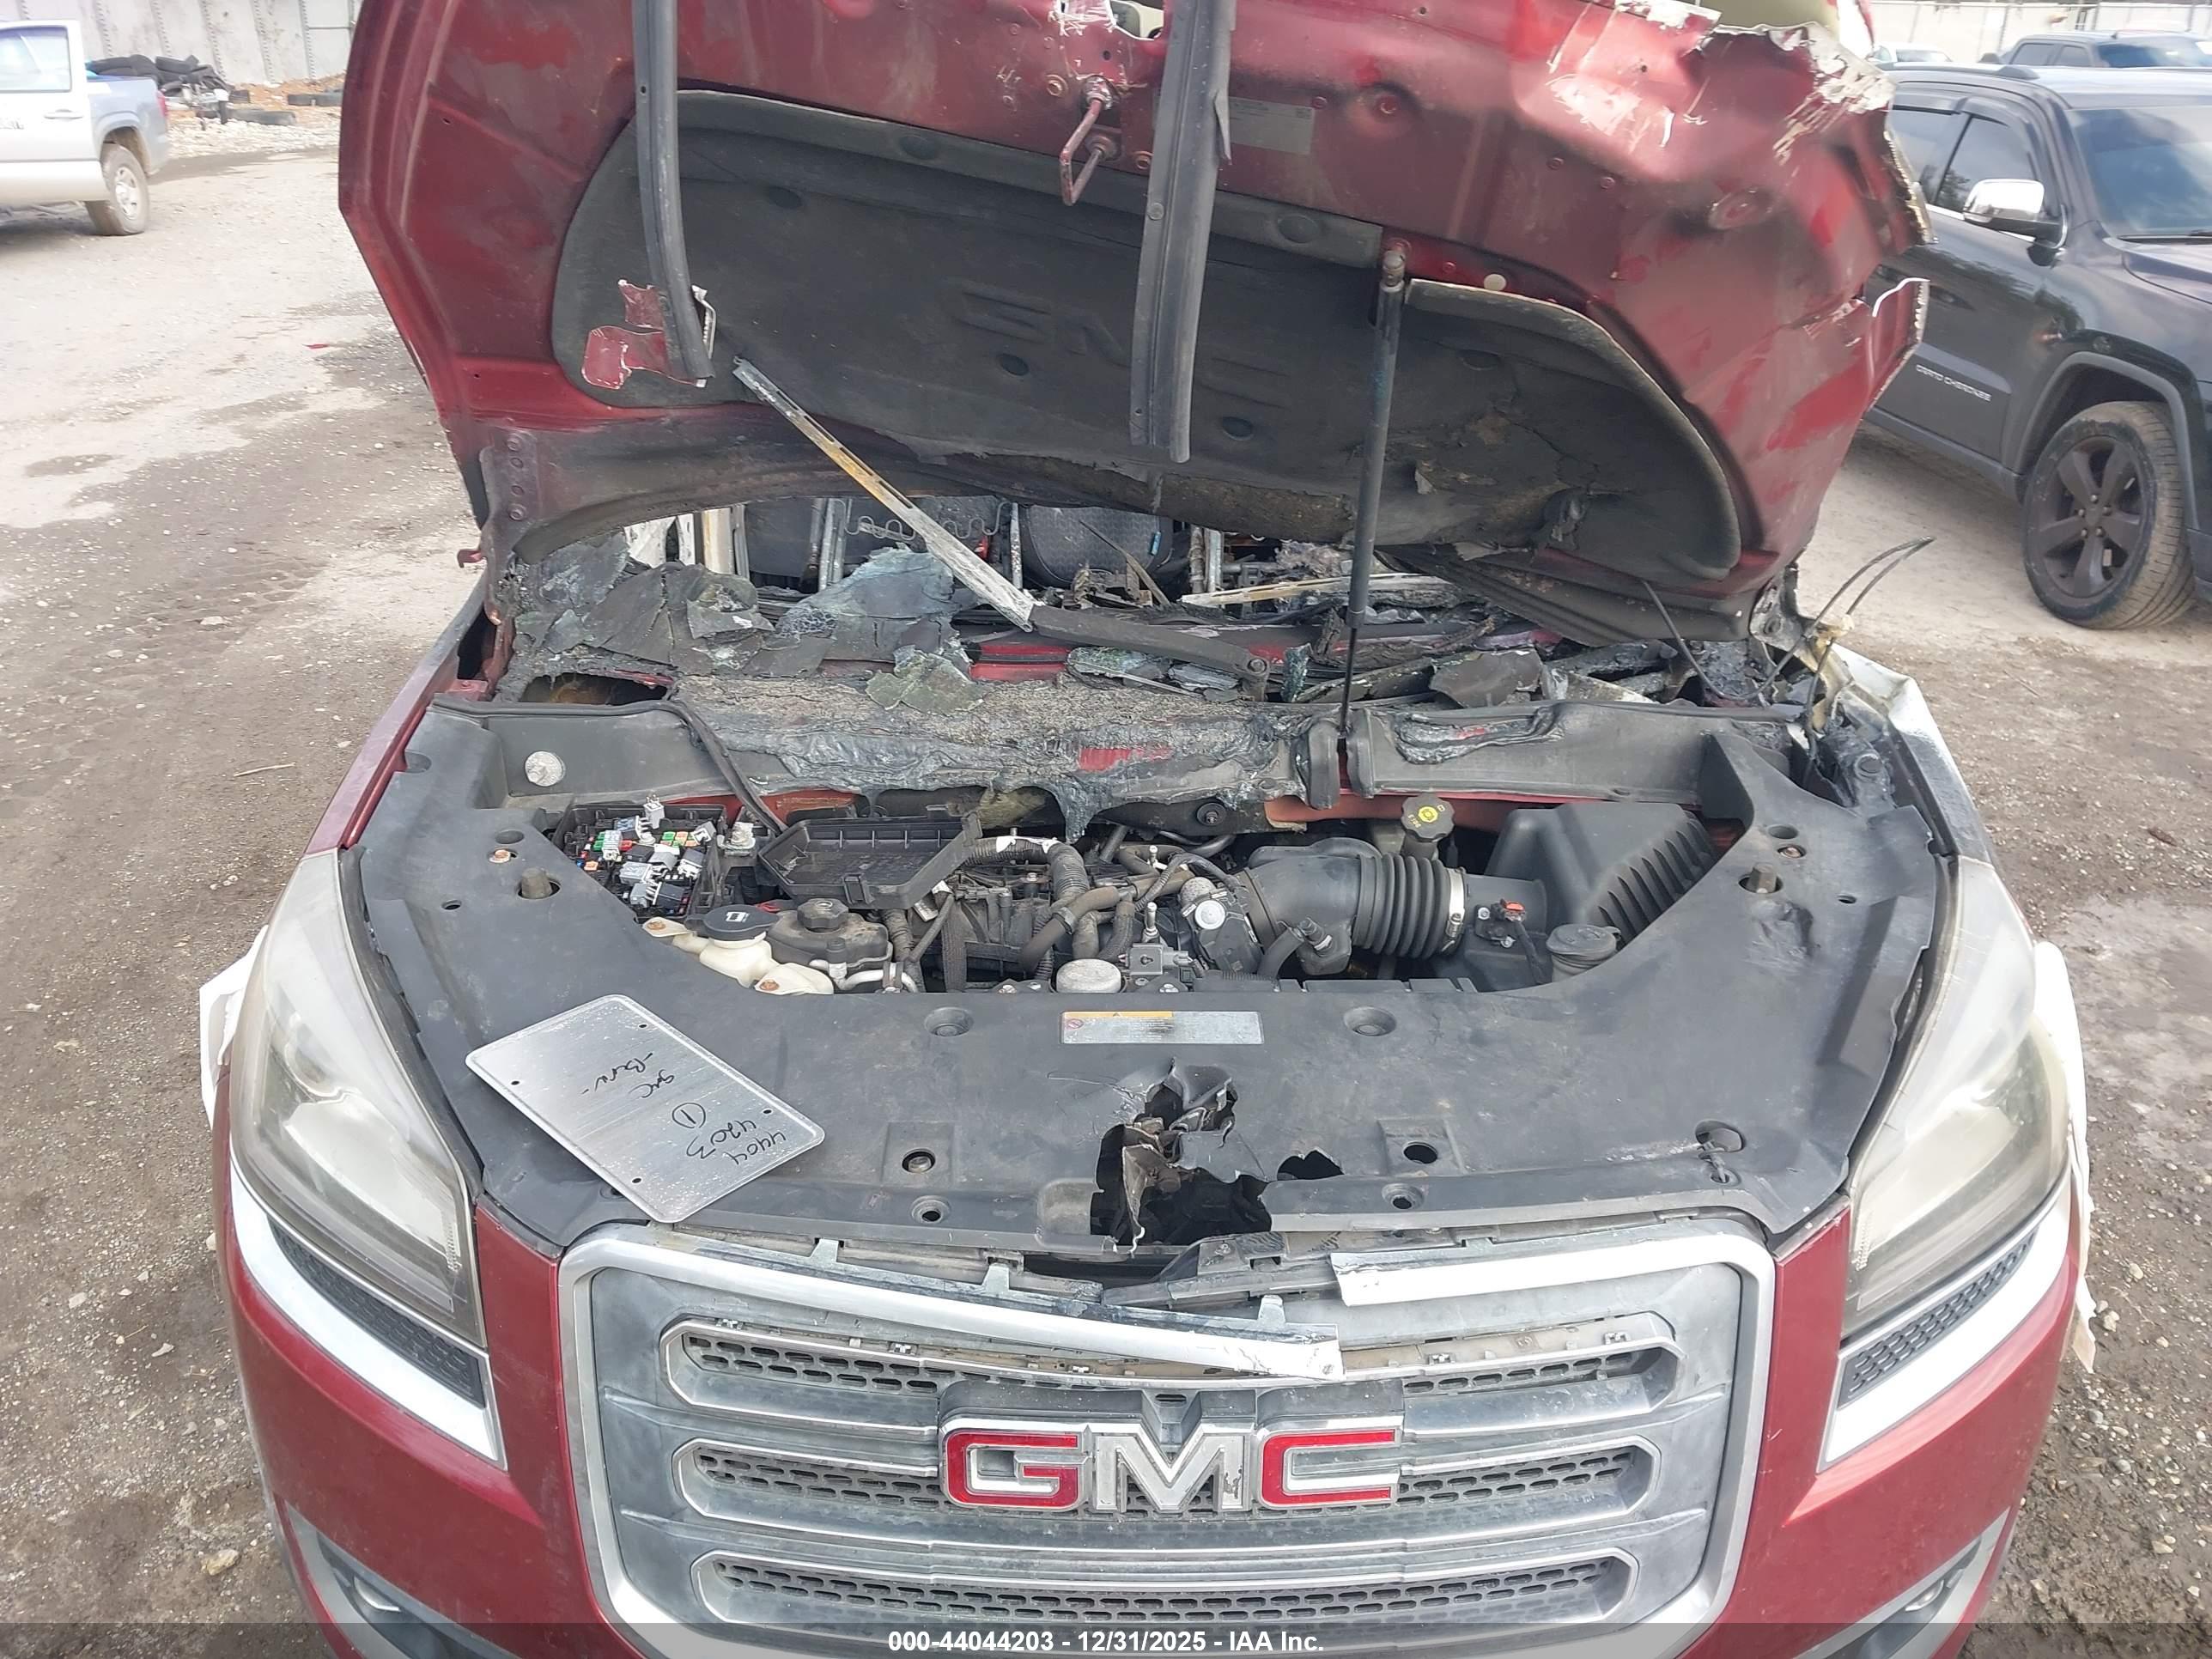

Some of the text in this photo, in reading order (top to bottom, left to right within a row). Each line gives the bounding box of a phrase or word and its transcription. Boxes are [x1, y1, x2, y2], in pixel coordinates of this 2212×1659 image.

[685, 1118, 757, 1159] 4203
[725, 1129, 787, 1165] 4404
[941, 1418, 1406, 1511] GMC
